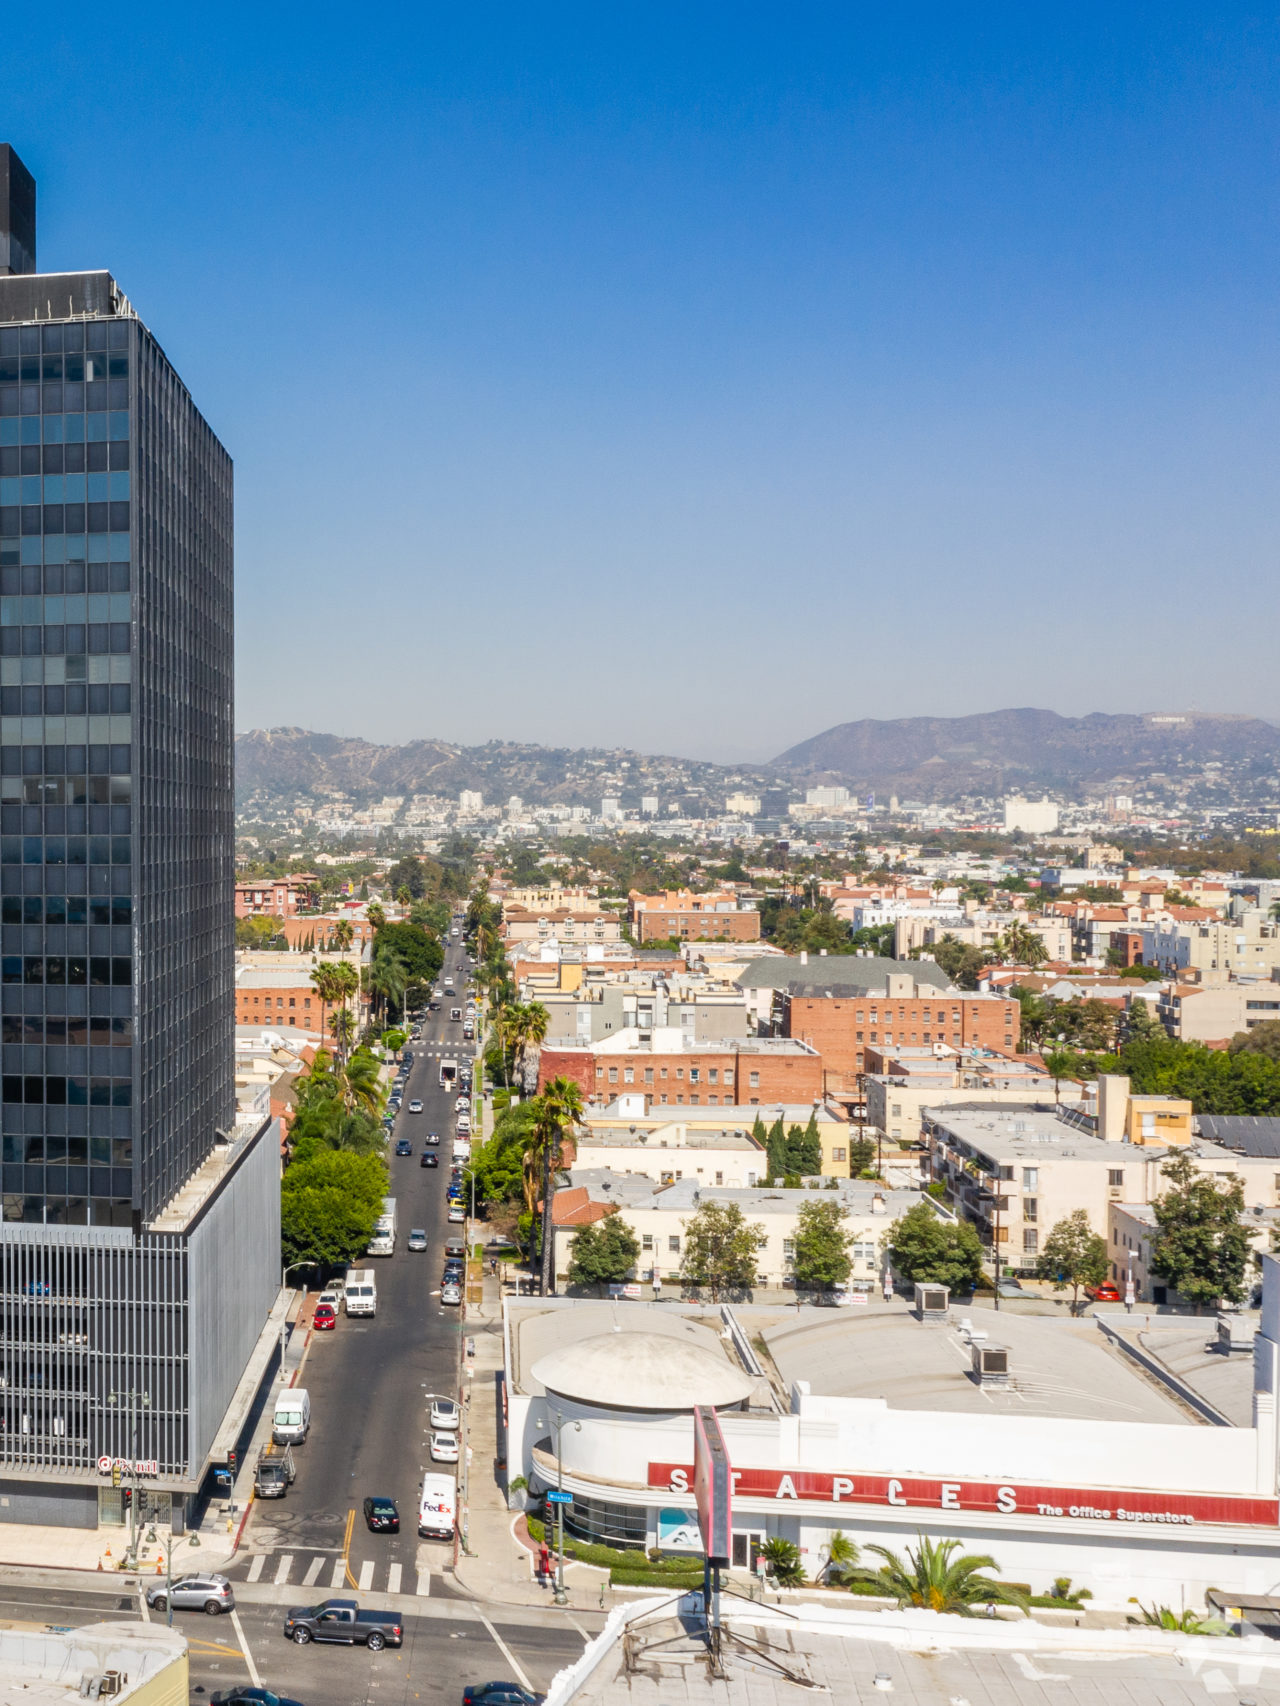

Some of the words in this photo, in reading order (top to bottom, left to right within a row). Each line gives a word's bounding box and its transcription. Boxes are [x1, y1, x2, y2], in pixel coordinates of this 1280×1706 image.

[115, 1458, 157, 1474] Dnil
[670, 1469, 1017, 1514] STAPLES
[423, 1501, 452, 1513] FedEx
[1037, 1503, 1064, 1517] The
[1069, 1505, 1112, 1519] Office
[1116, 1508, 1195, 1525] Superstore
